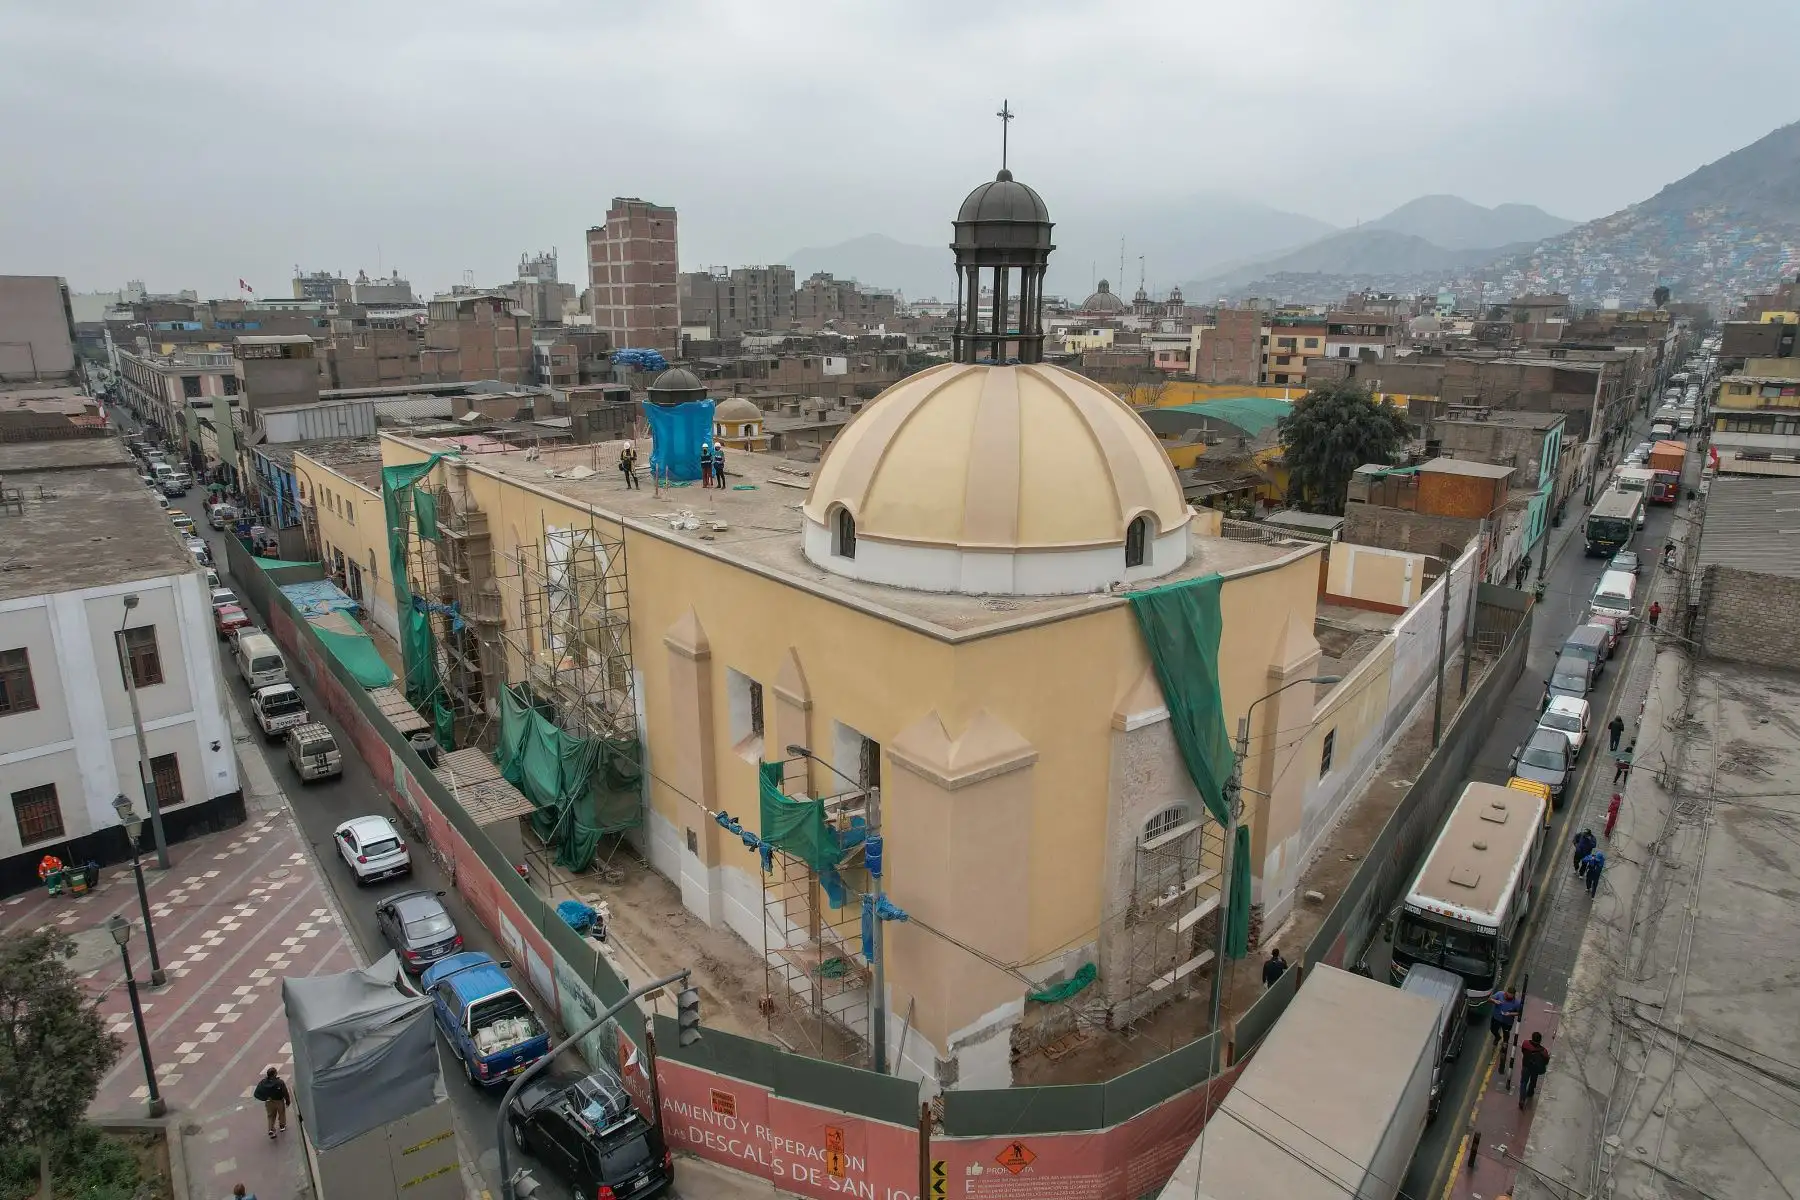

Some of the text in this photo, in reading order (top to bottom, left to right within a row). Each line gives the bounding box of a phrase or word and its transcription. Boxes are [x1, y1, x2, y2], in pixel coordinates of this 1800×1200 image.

[276, 718, 300, 726] TOYOTA
[740, 1120, 750, 1135] Y
[792, 1163, 822, 1187] DE
[829, 1174, 874, 1200] SAN
